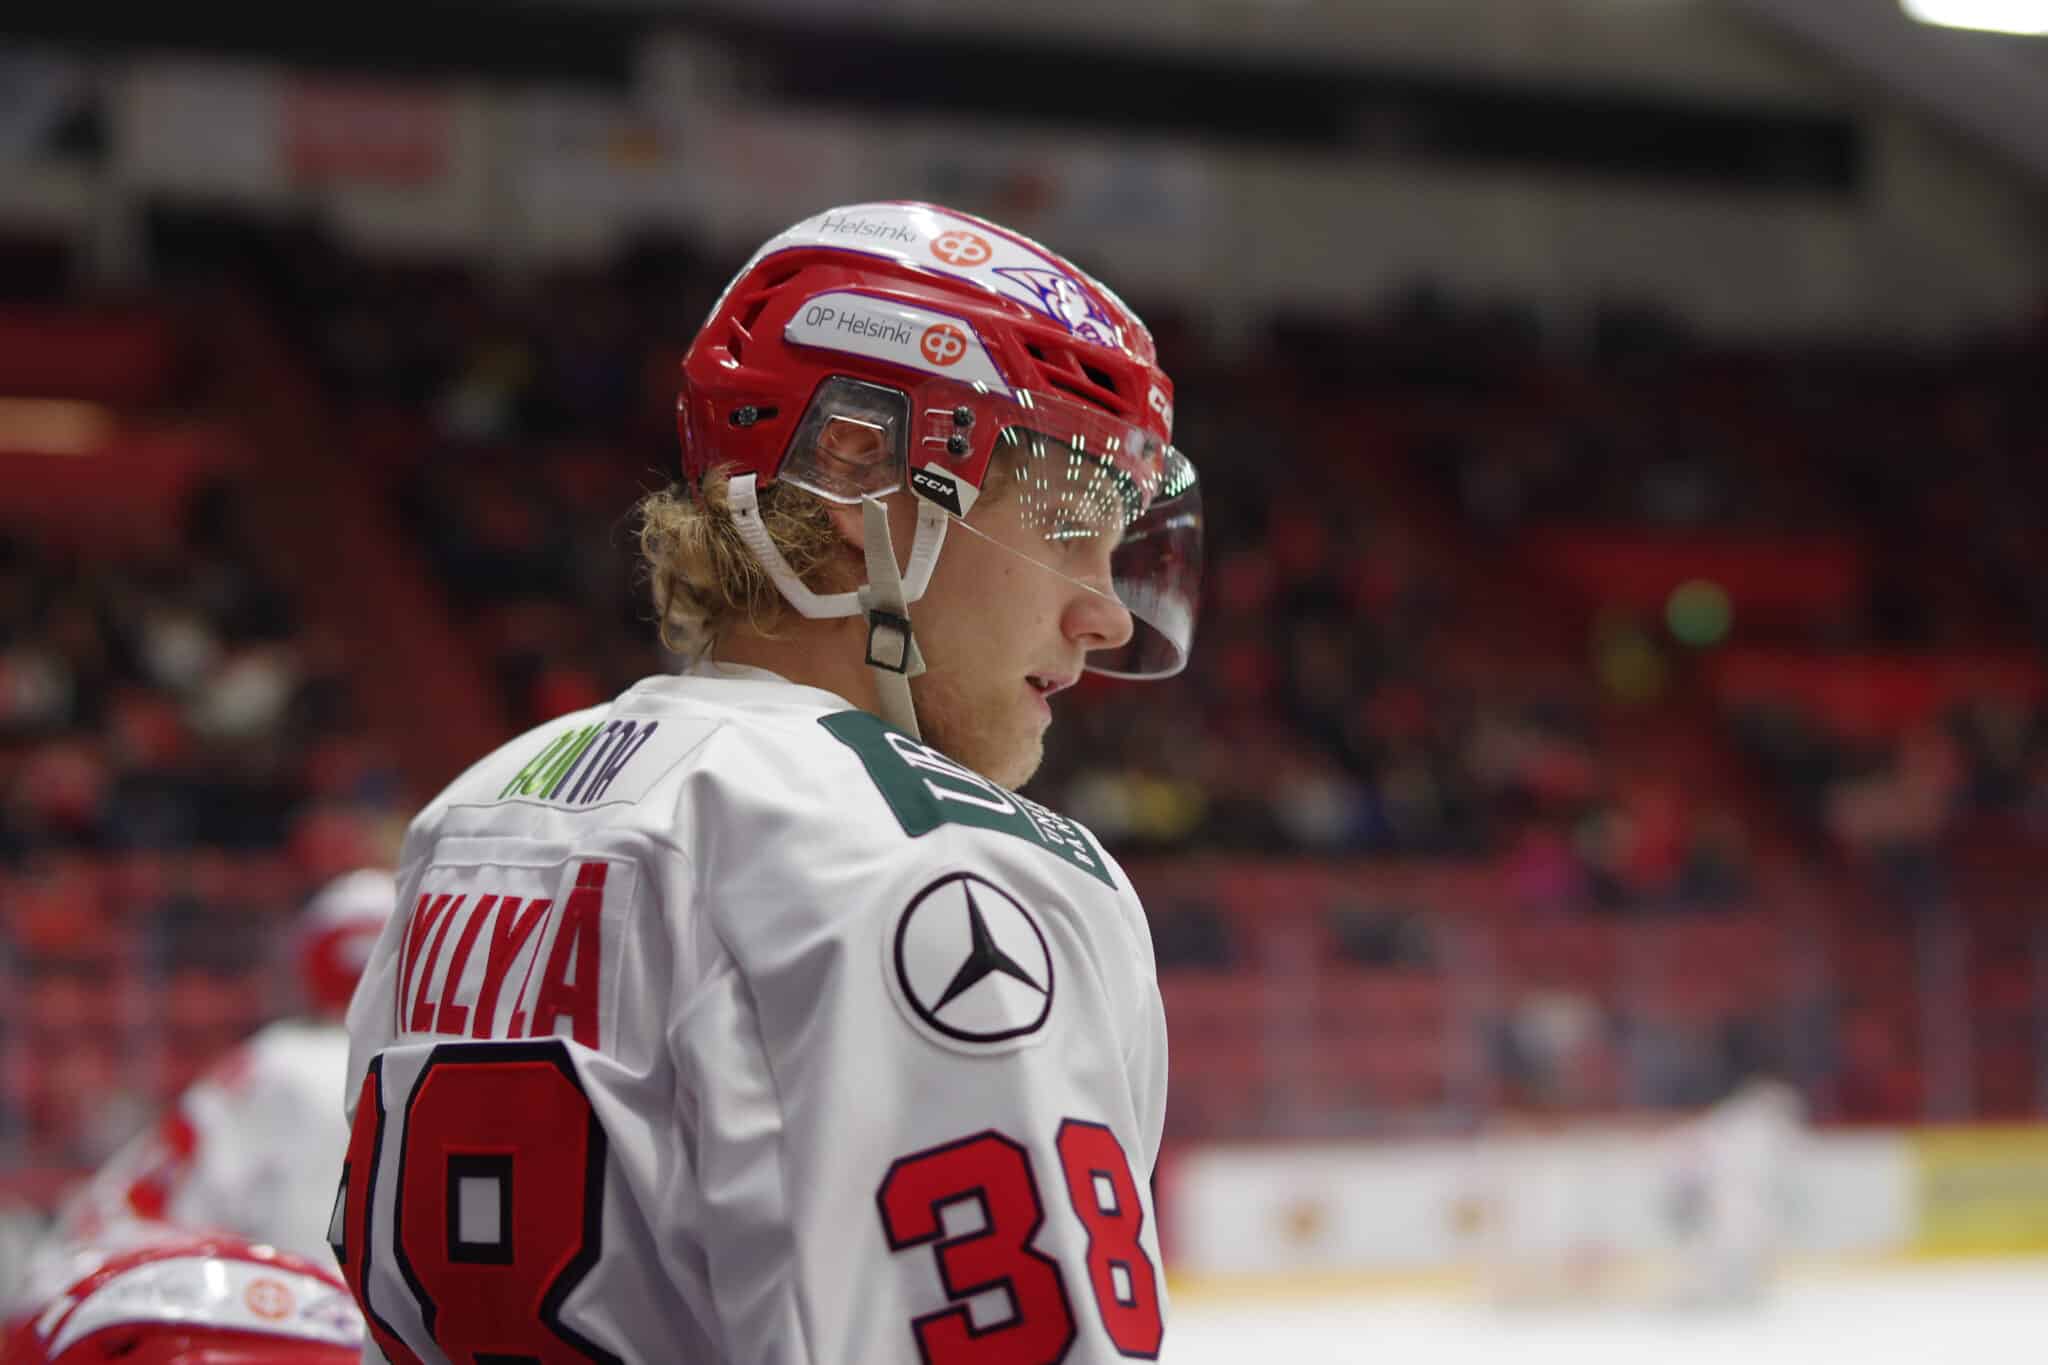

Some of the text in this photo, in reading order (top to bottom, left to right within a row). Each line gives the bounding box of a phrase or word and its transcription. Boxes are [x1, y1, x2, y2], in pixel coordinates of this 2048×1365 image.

[819, 215, 918, 244] Helsinki
[805, 305, 913, 345] OP Helsinki
[913, 473, 954, 496] CCM
[394, 860, 609, 1051] YLLYLÄ
[327, 1039, 627, 1365] 8
[875, 1117, 1164, 1365] 38
